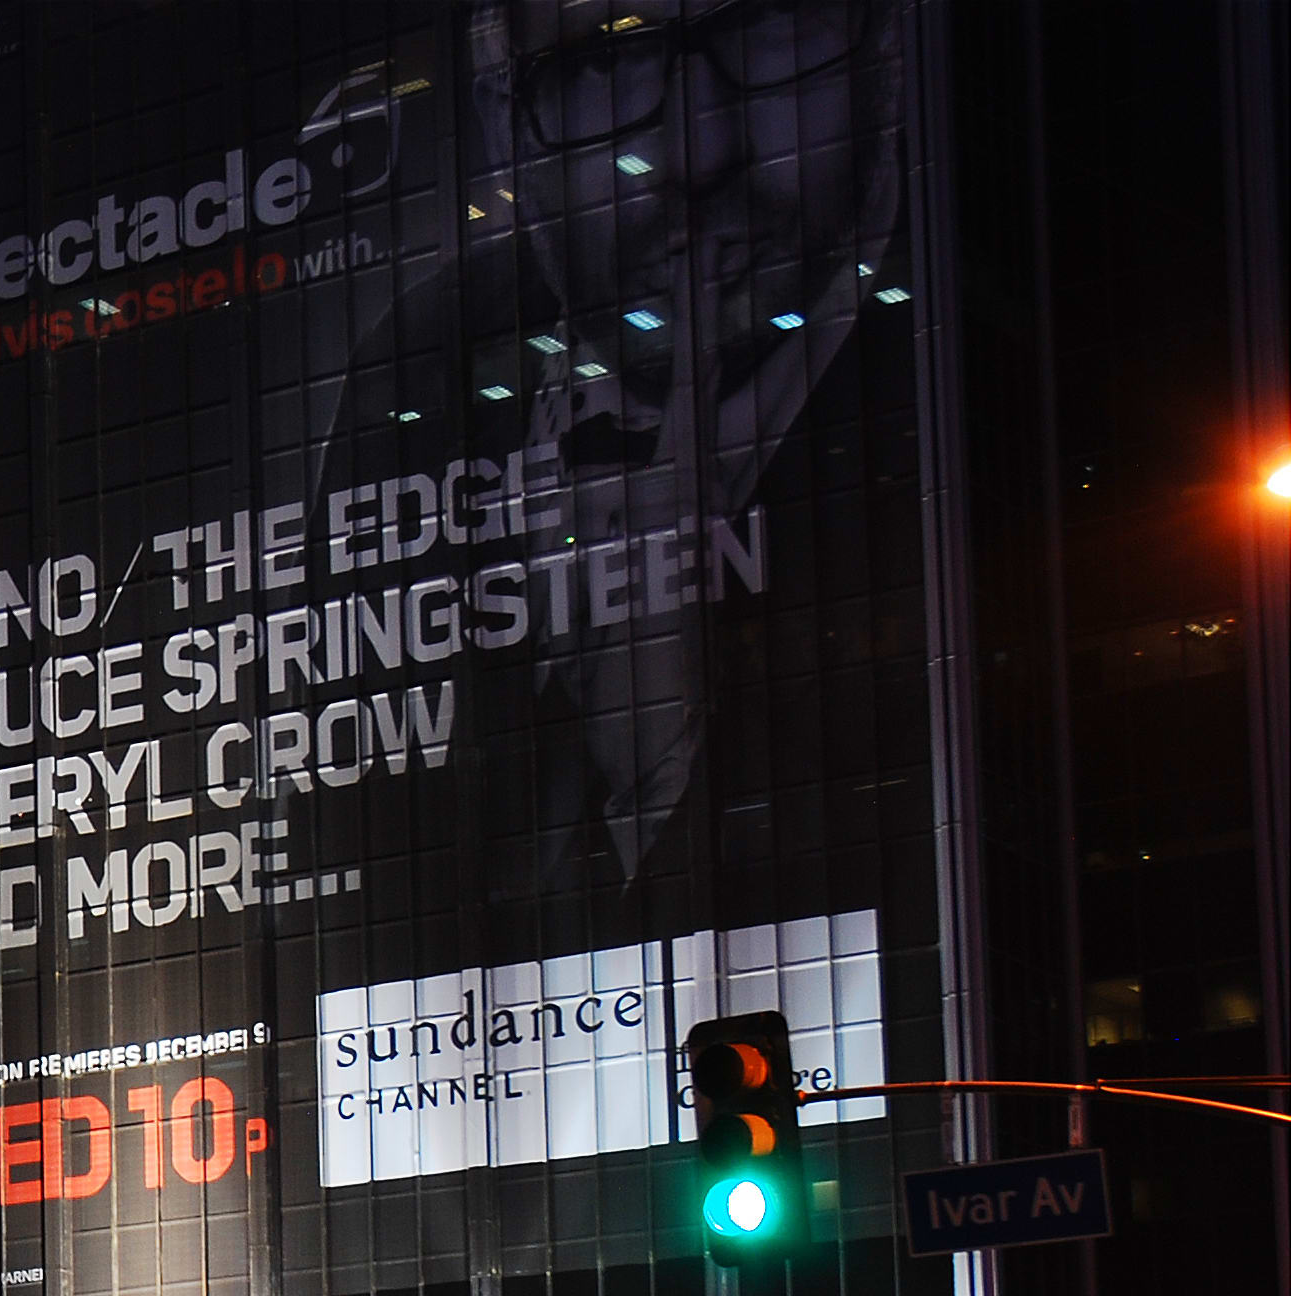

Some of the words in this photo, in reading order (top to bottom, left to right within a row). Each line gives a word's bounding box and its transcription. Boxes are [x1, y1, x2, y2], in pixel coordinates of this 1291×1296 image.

[83, 241, 287, 341] costelo
[154, 501, 306, 612] THE
[328, 444, 561, 574] EDGE
[162, 504, 768, 715] SPRINGSTEEN
[207, 680, 456, 809] CROW
[66, 819, 361, 940] MORE...
[29, 1043, 141, 1079] PREMIERES
[145, 1028, 248, 1065] DECEMBER
[336, 988, 644, 1071] sundance
[337, 1071, 524, 1120] CHANNEL
[926, 1189, 1019, 1230] Ivar
[1029, 1176, 1075, 1219] Av
